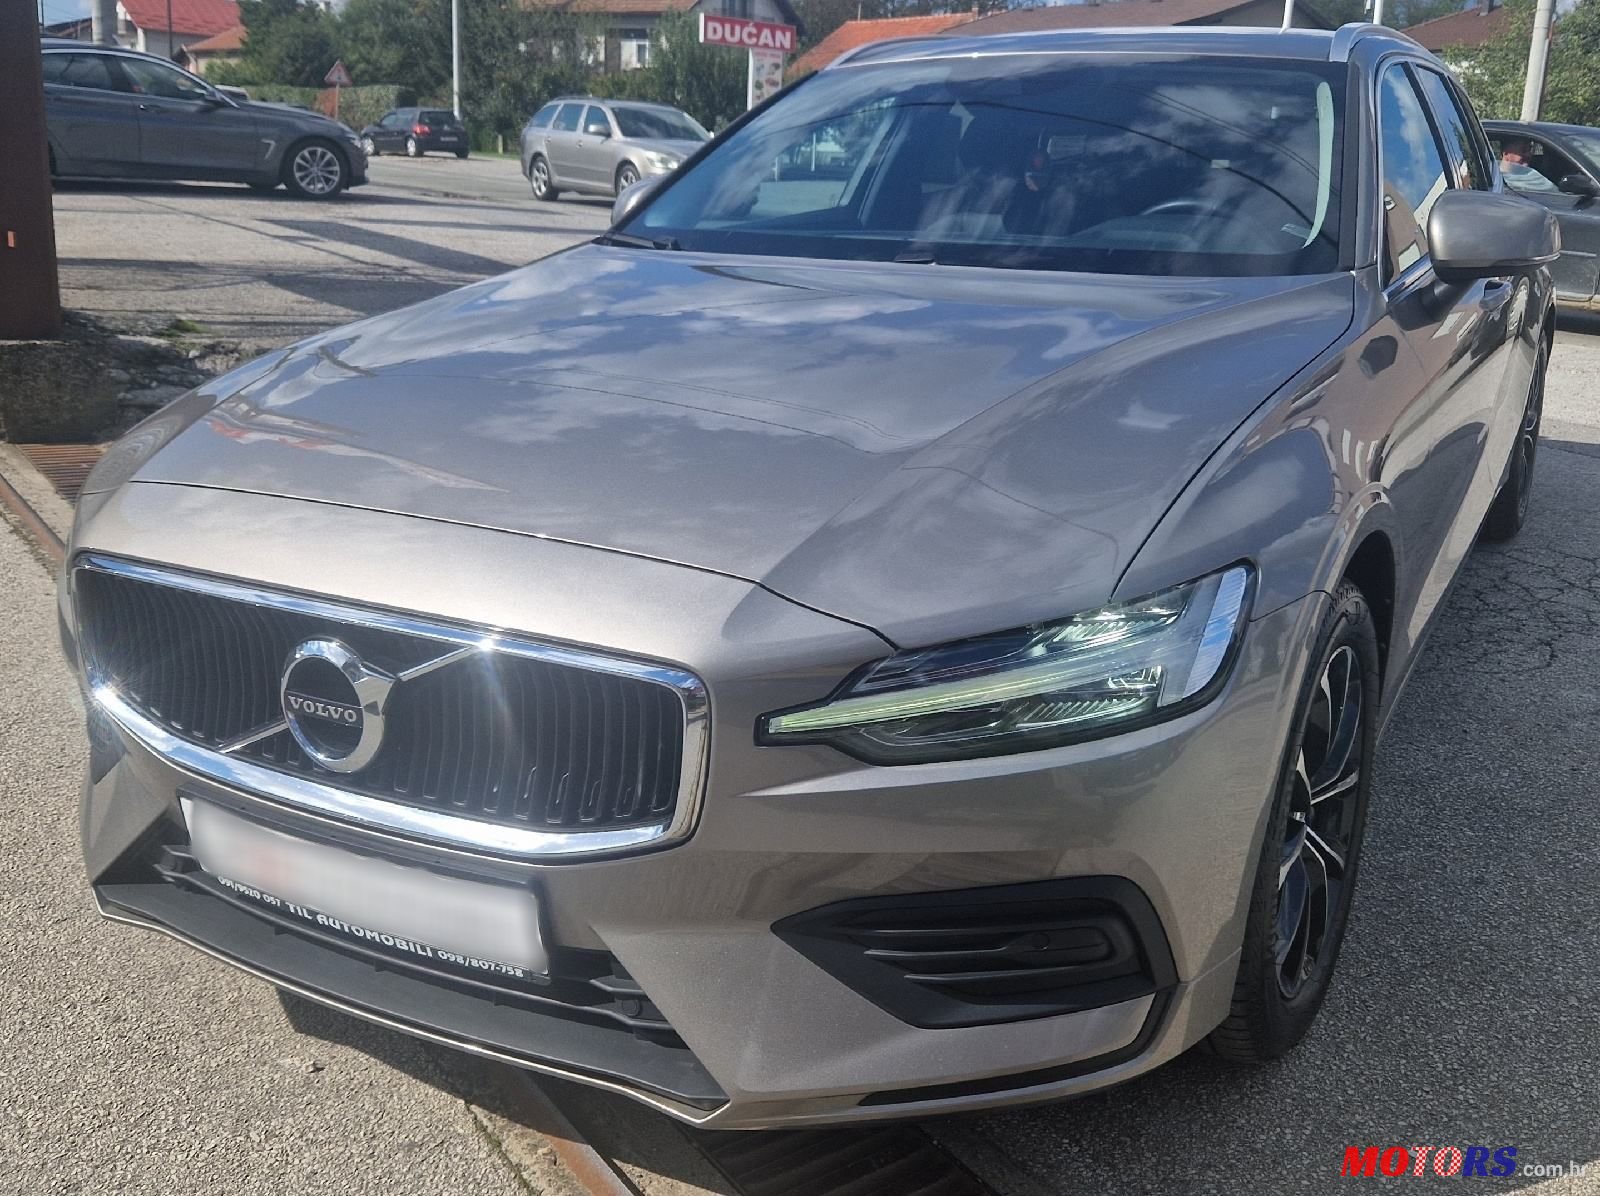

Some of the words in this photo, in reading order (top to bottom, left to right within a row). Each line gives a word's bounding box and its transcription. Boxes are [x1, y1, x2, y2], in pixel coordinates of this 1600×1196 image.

[706, 21, 791, 49] DUĆAN
[287, 695, 357, 722] VOLVO
[285, 901, 313, 920] TIL
[316, 914, 433, 957] AUTOMOBILI
[437, 950, 524, 978] 098/807-758
